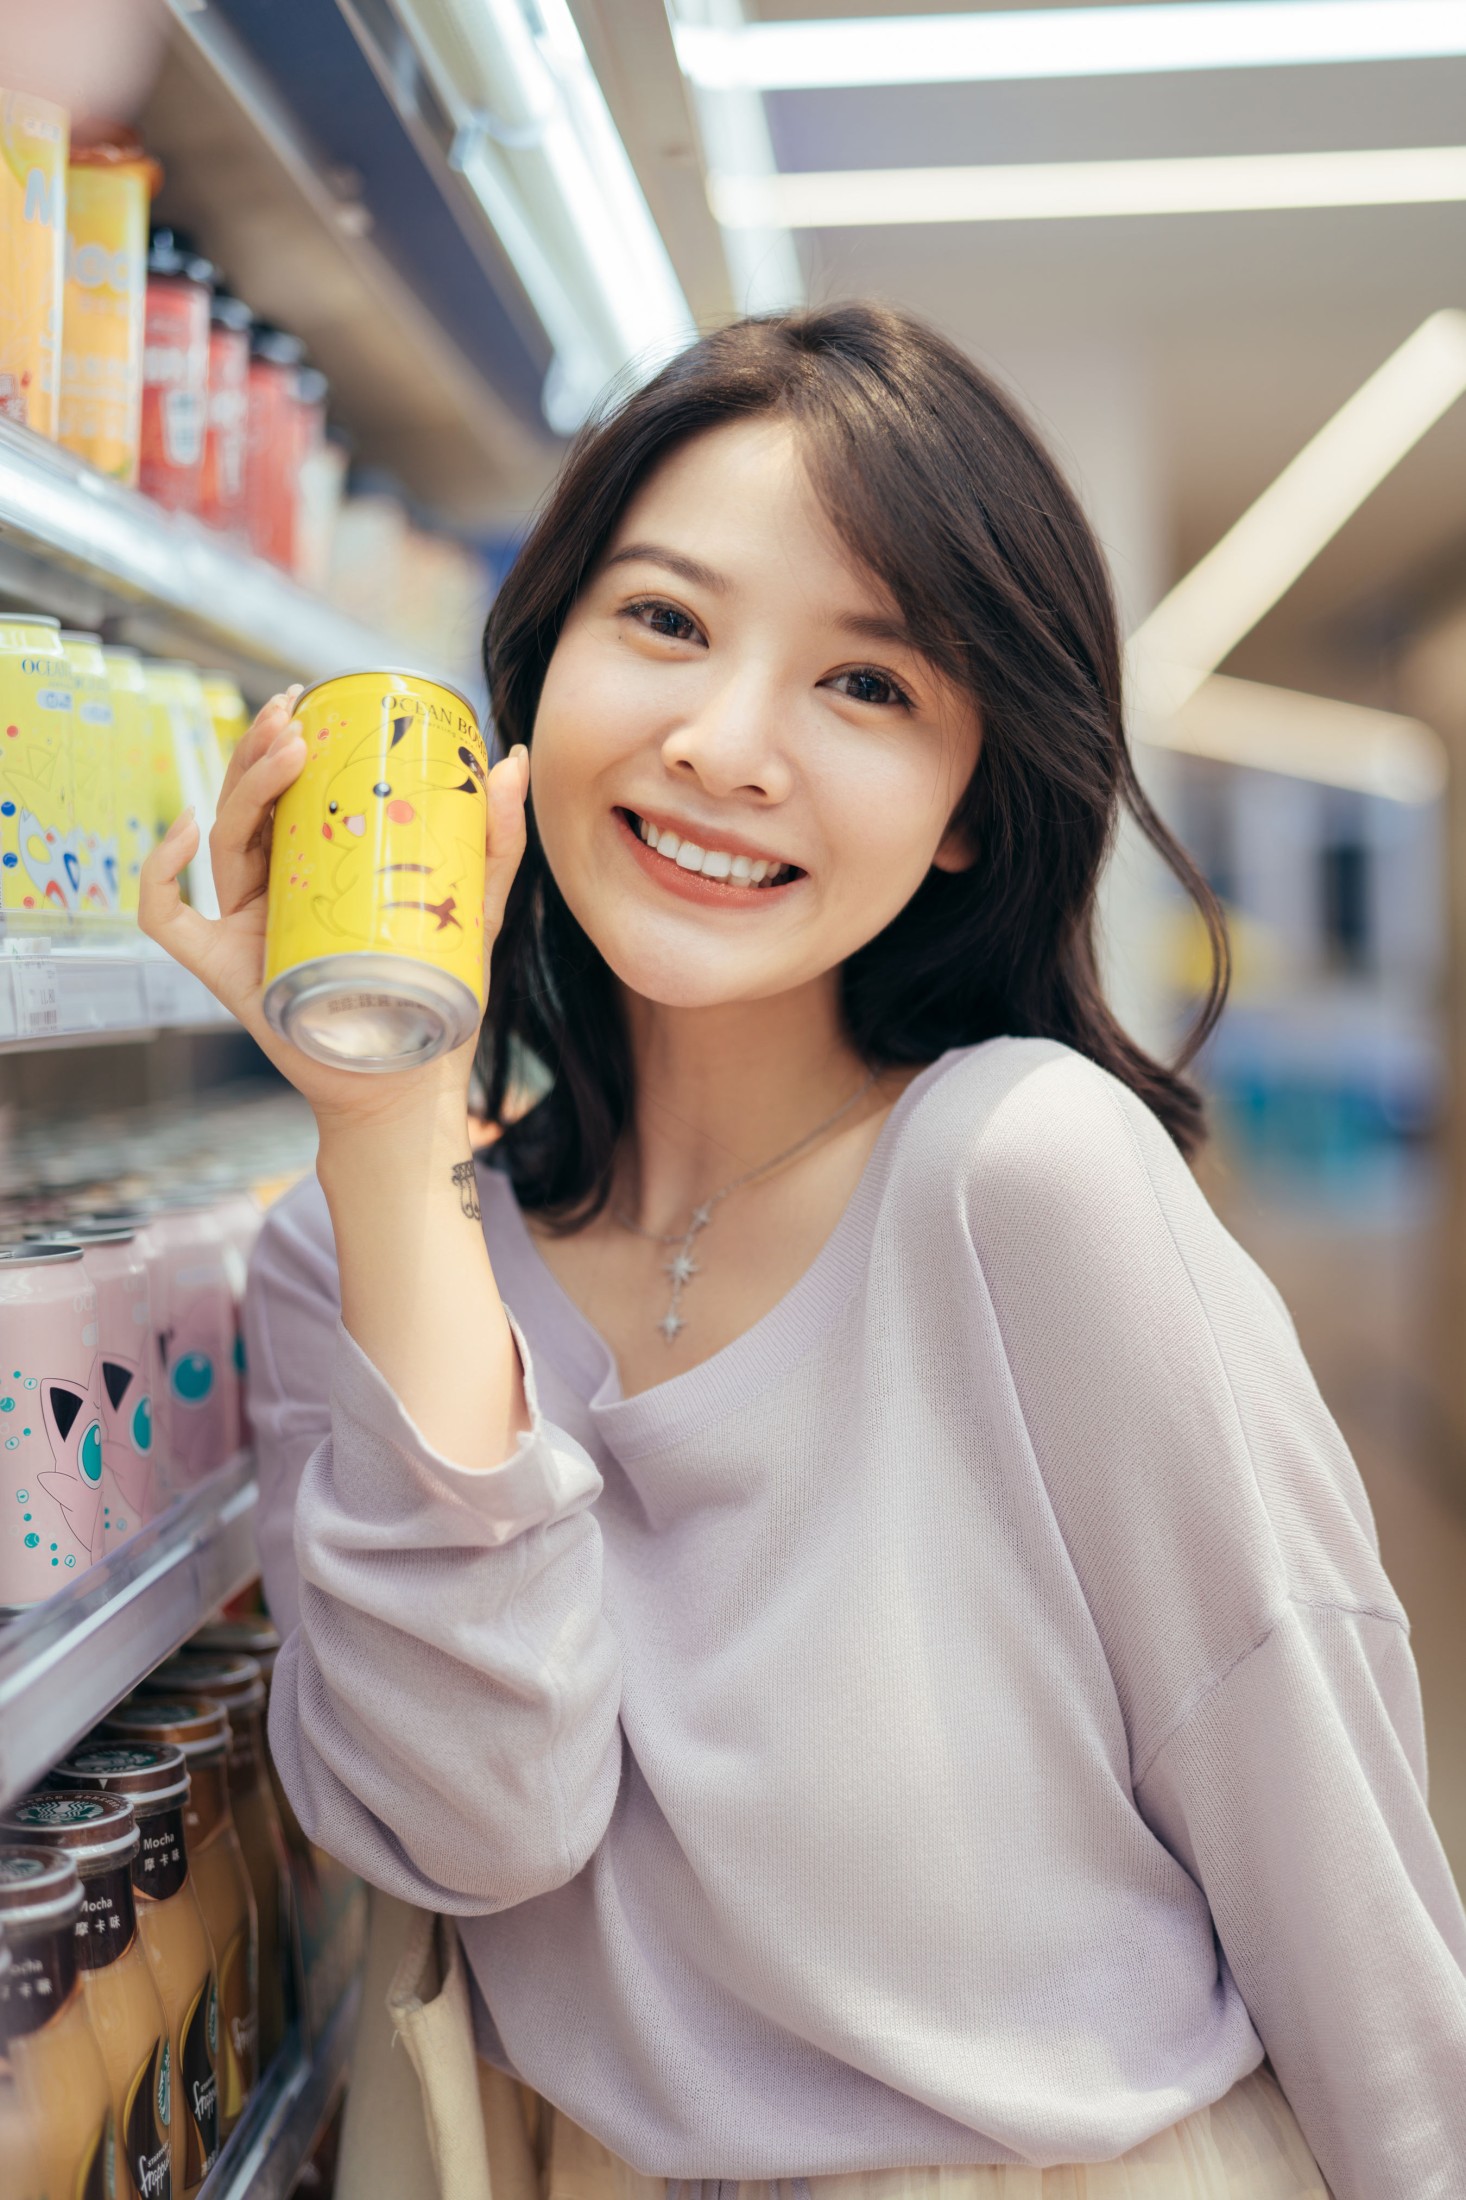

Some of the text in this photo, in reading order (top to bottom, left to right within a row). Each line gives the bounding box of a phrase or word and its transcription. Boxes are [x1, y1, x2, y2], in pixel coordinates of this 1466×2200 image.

[382, 695, 452, 726] OCEAN
[143, 1832, 175, 1850] Mocha
[144, 1848, 180, 1872] 摩卡味
[75, 1914, 121, 1937] 摩卡味
[10, 1958, 44, 1977] ocha
